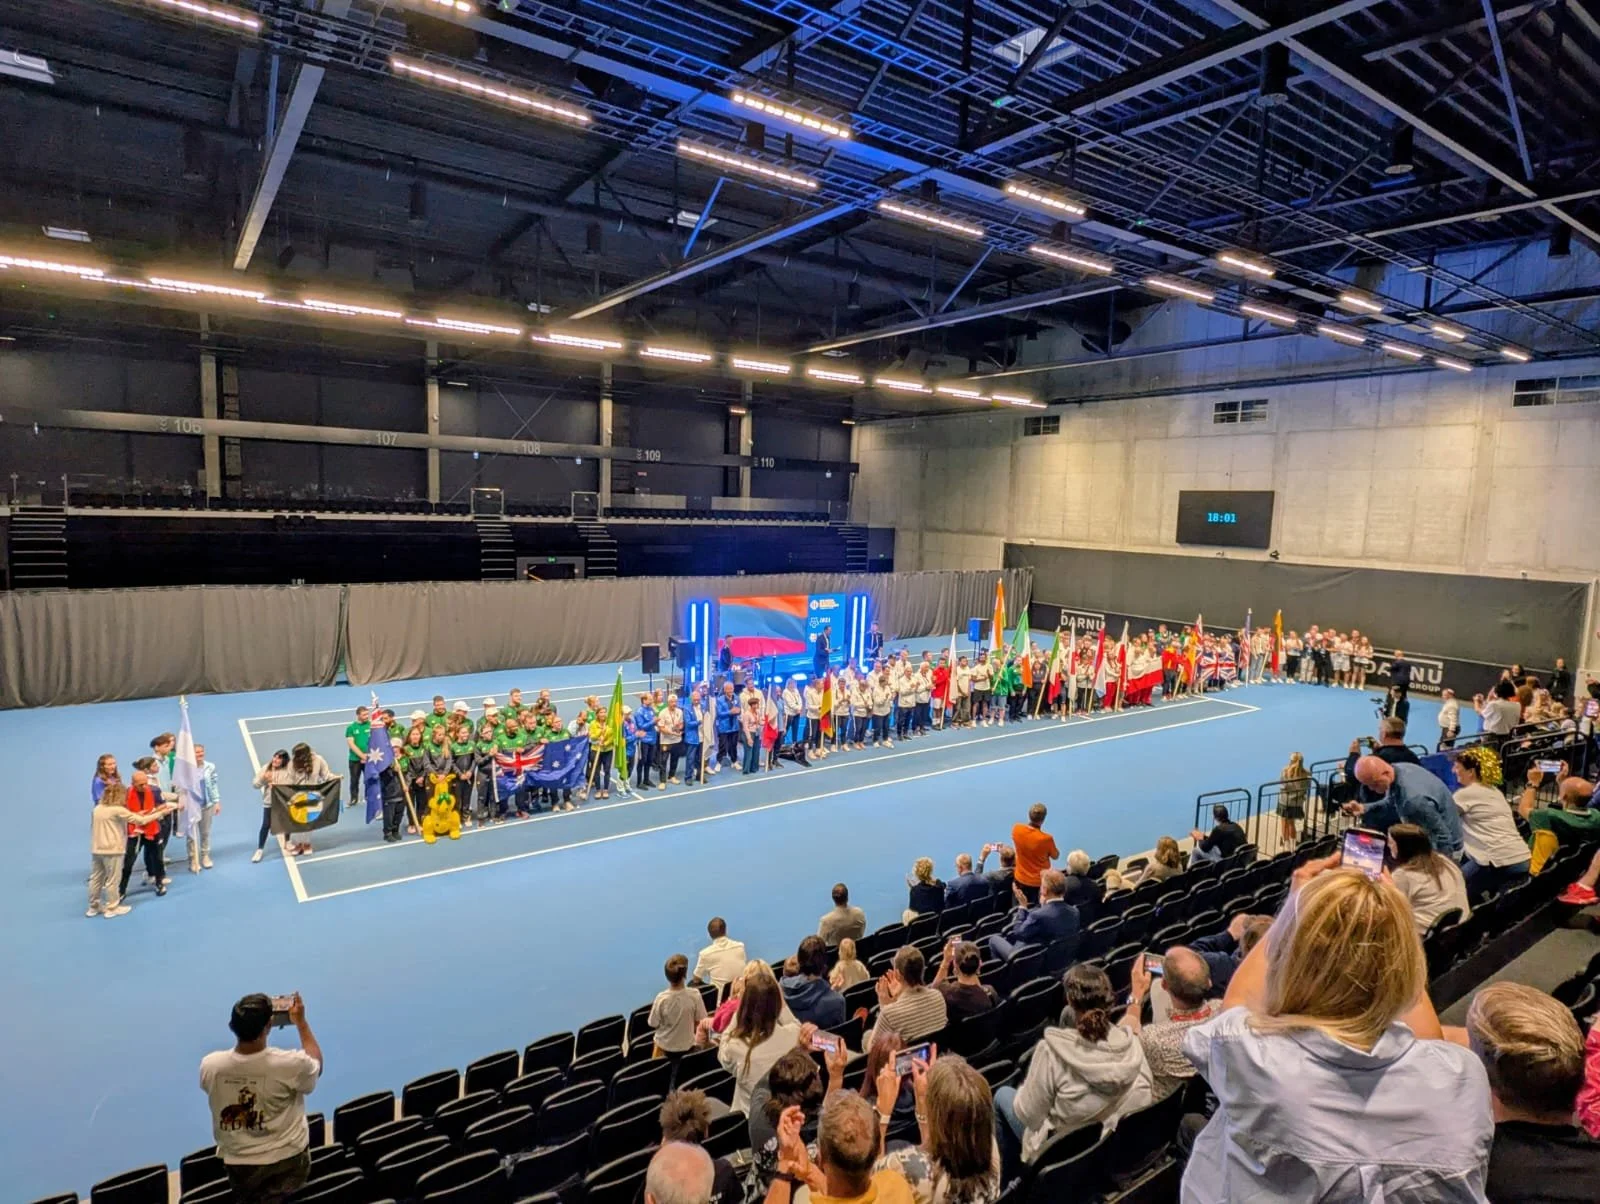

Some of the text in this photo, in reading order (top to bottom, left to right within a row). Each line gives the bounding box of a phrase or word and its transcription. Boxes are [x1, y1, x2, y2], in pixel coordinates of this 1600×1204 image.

[376, 431, 398, 446] 107
[522, 440, 541, 455] 108
[645, 449, 661, 461] 109
[761, 457, 775, 468] 110
[1207, 512, 1237, 523] 18:01
[1364, 660, 1444, 684] DANU
[1409, 682, 1441, 692] GROUP
